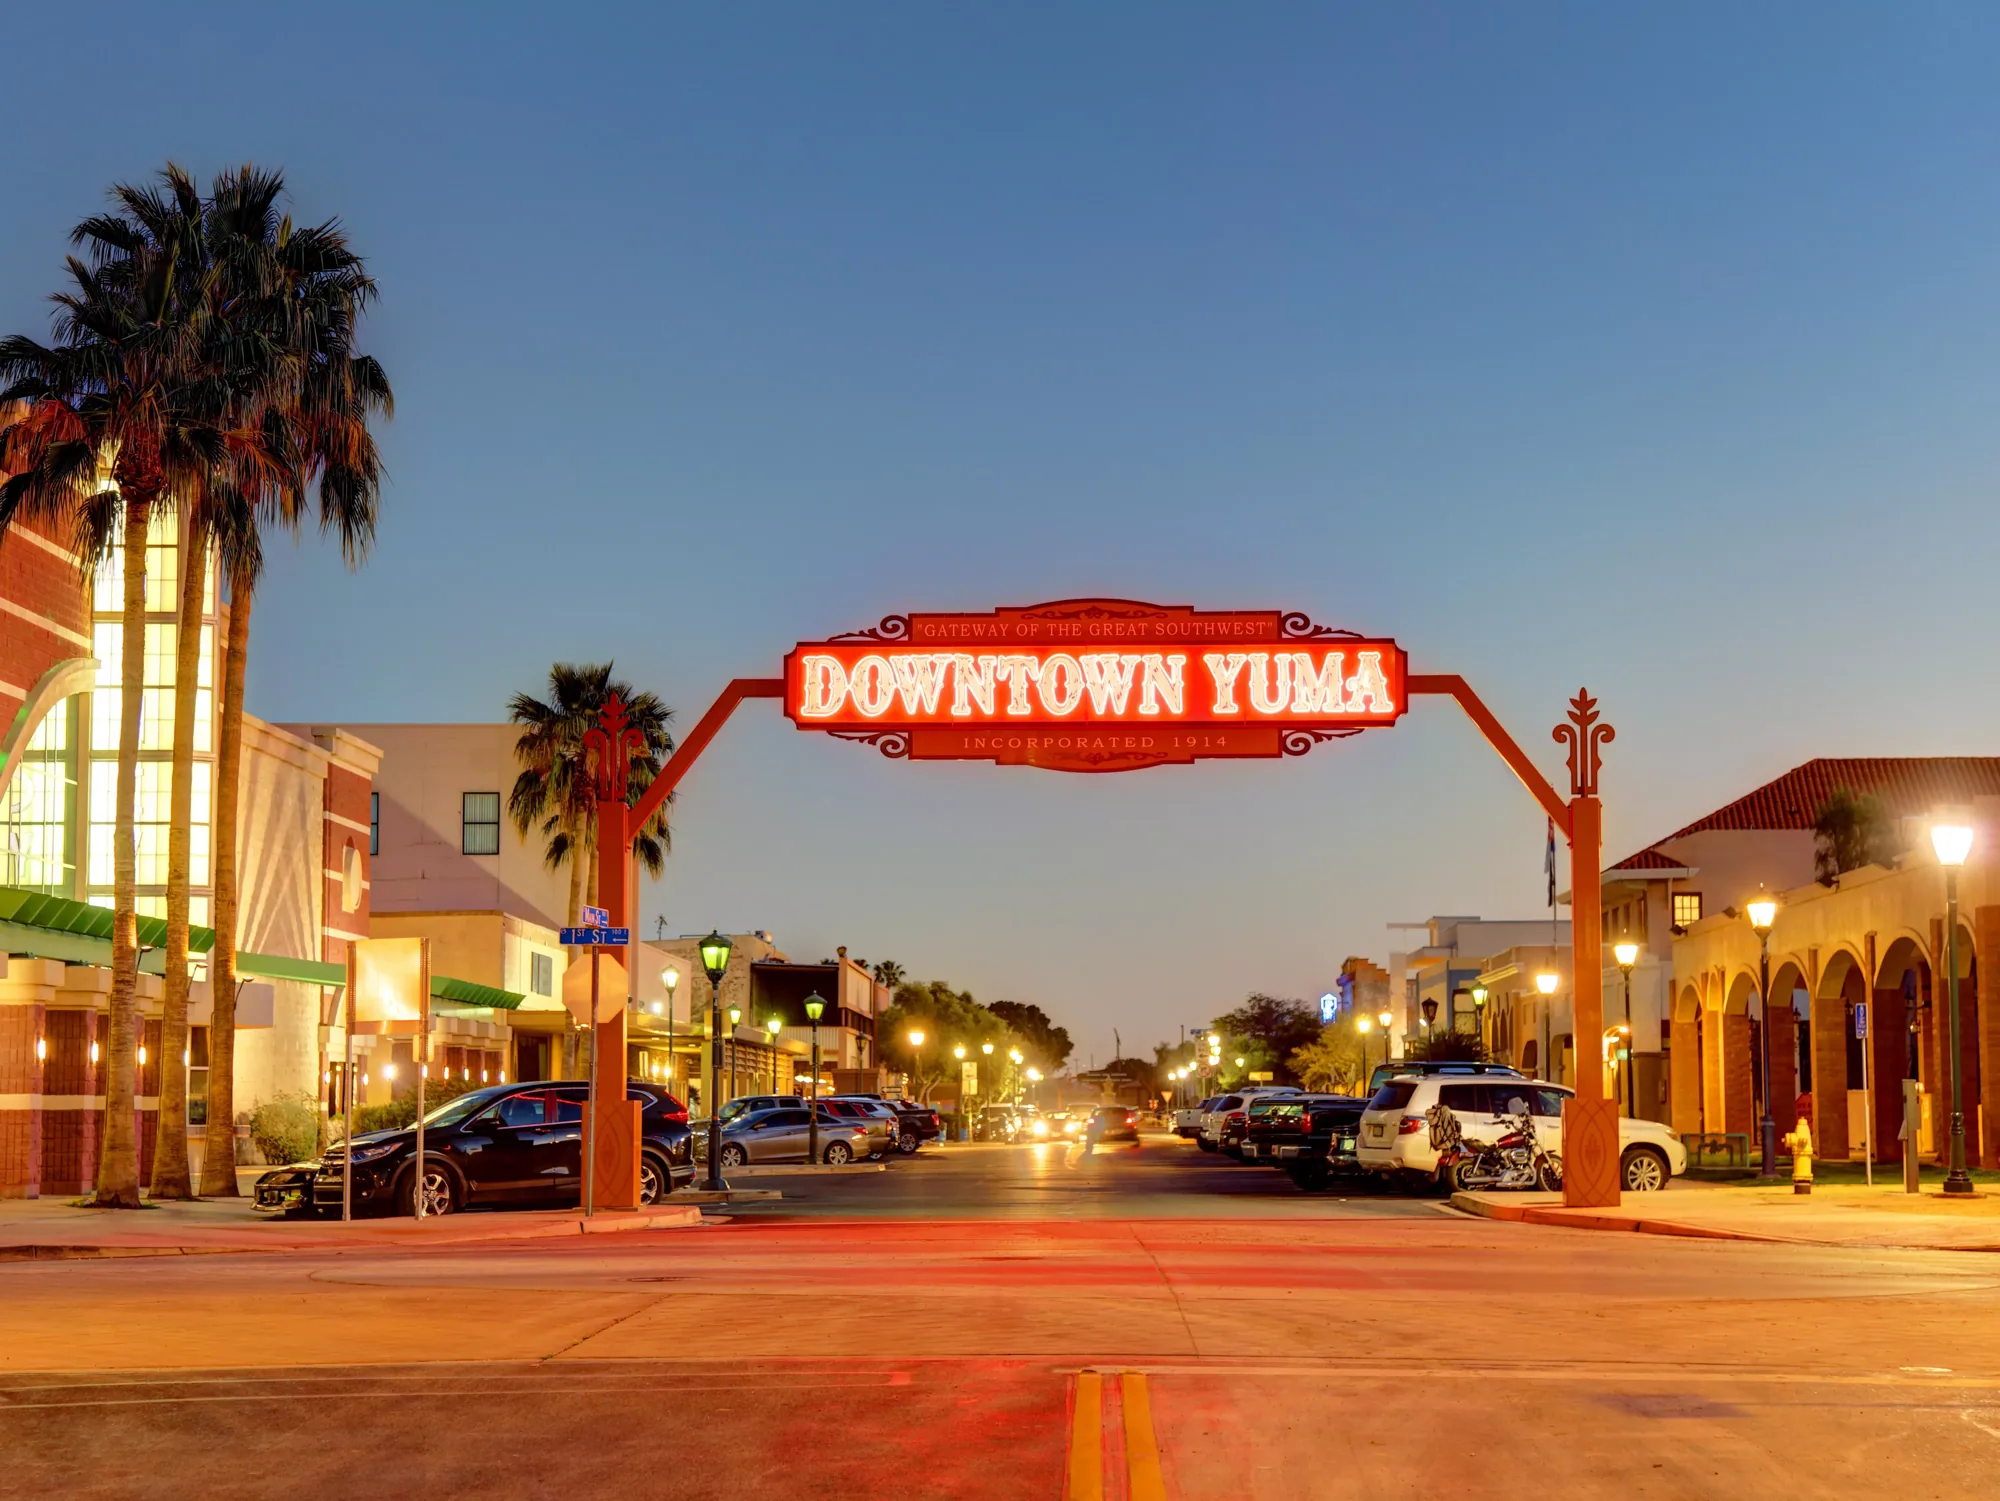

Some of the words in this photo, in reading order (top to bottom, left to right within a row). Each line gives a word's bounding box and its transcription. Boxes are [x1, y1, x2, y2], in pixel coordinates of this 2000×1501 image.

[917, 623, 1009, 637] "GATEWAY
[1016, 623, 1040, 637] OF
[1047, 623, 1082, 637] THE
[1089, 622, 1149, 636] GREAT
[1155, 621, 1273, 636] SOUTHWEST"
[801, 653, 1187, 717] DOWNTOWN
[1203, 651, 1394, 714] YUMA
[963, 736, 1154, 749] INCORPORATED
[1172, 736, 1227, 748] 1914
[572, 929, 585, 944] 1ST
[592, 929, 607, 944] ST
